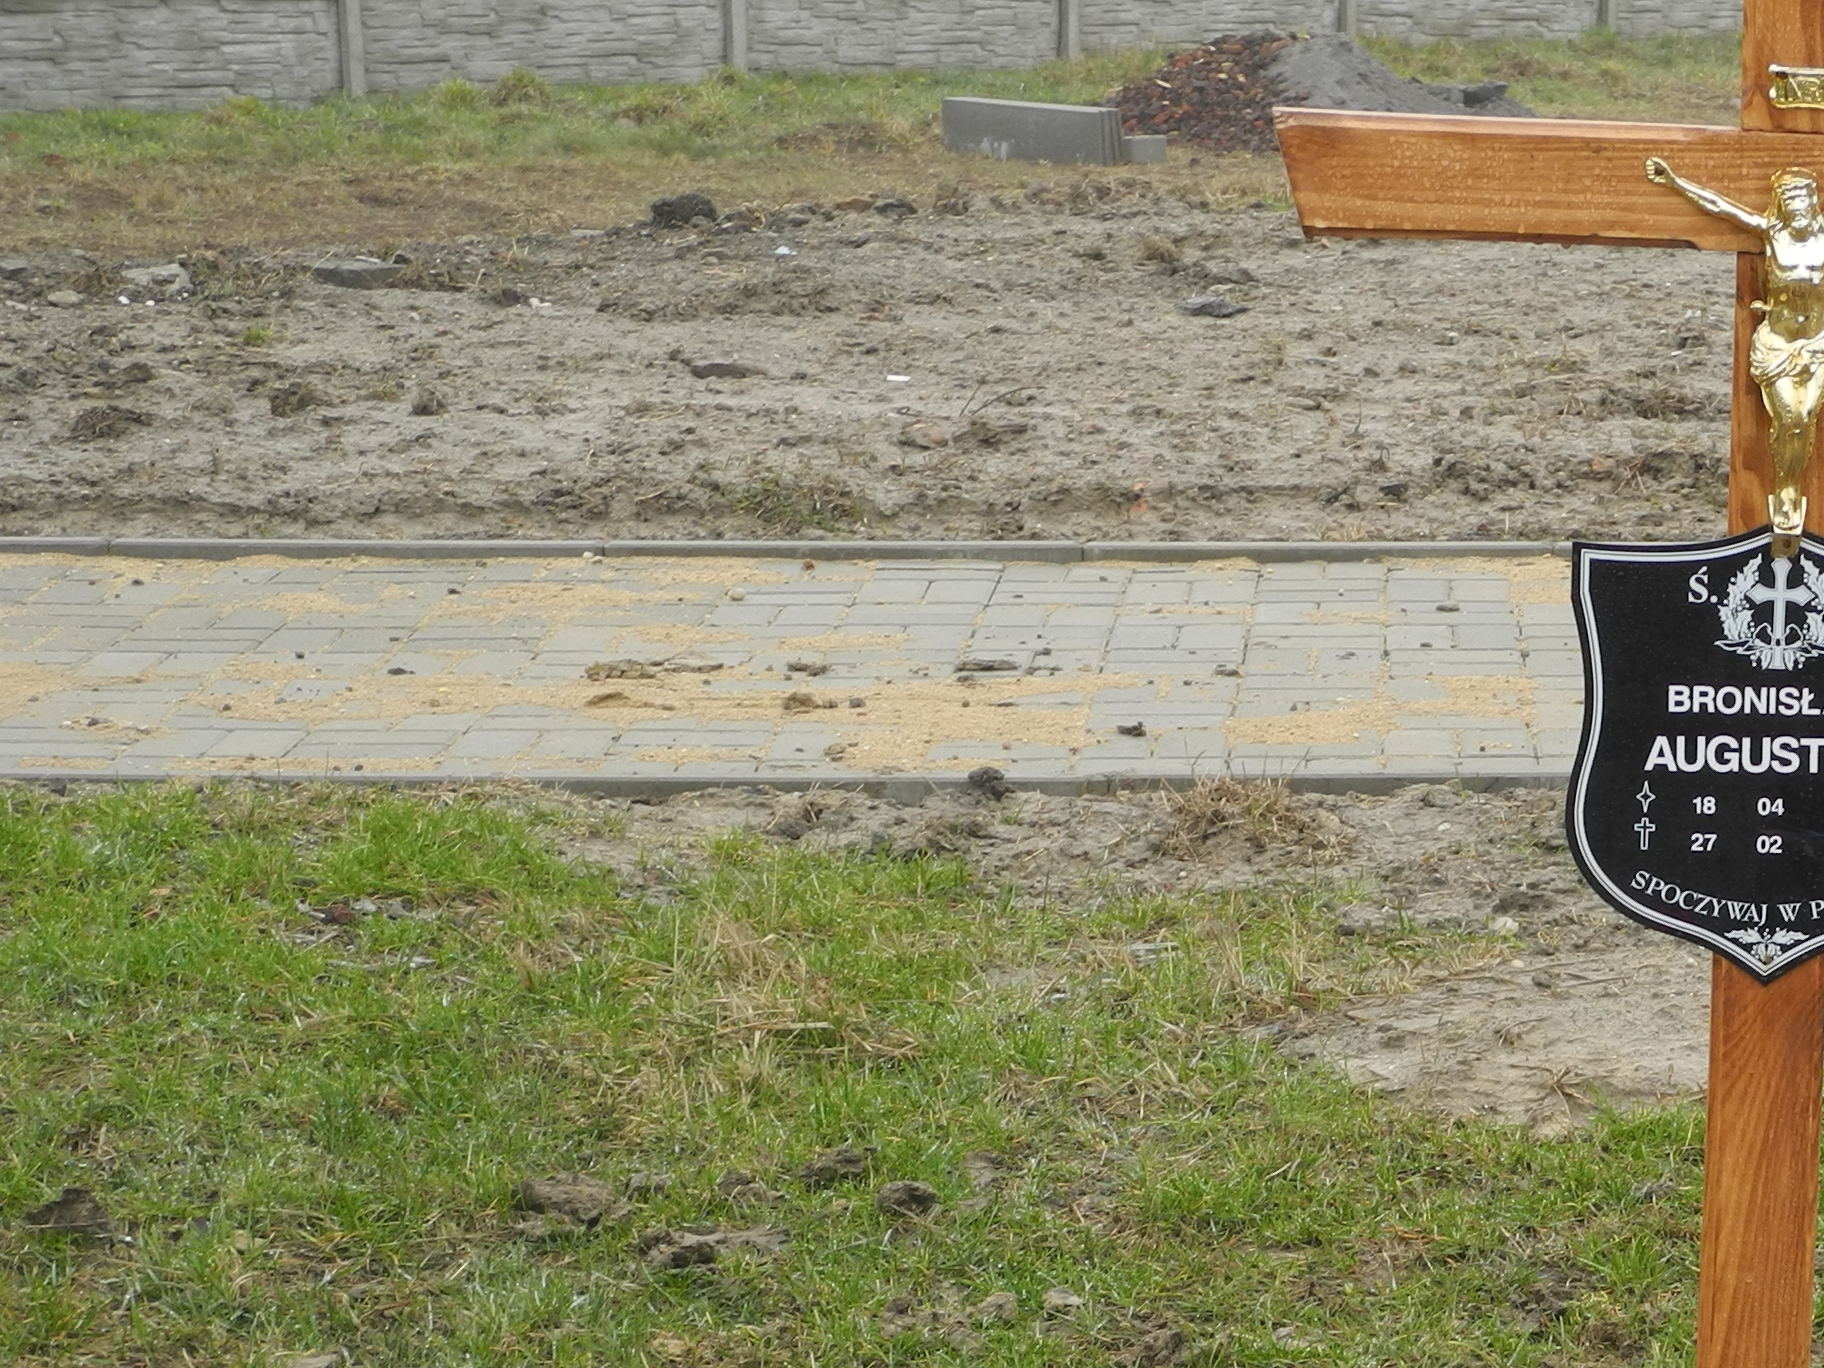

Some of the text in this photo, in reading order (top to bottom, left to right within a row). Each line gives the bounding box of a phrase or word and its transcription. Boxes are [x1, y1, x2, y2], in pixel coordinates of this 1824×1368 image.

[1687, 565, 1719, 604] Ś.
[1692, 796, 1717, 815] 18
[1757, 797, 1785, 816] 04
[1690, 832, 1718, 852] 27
[1756, 834, 1783, 854] 02
[1630, 869, 1769, 926] SPOCZYWAJ
[1776, 902, 1803, 923] W
